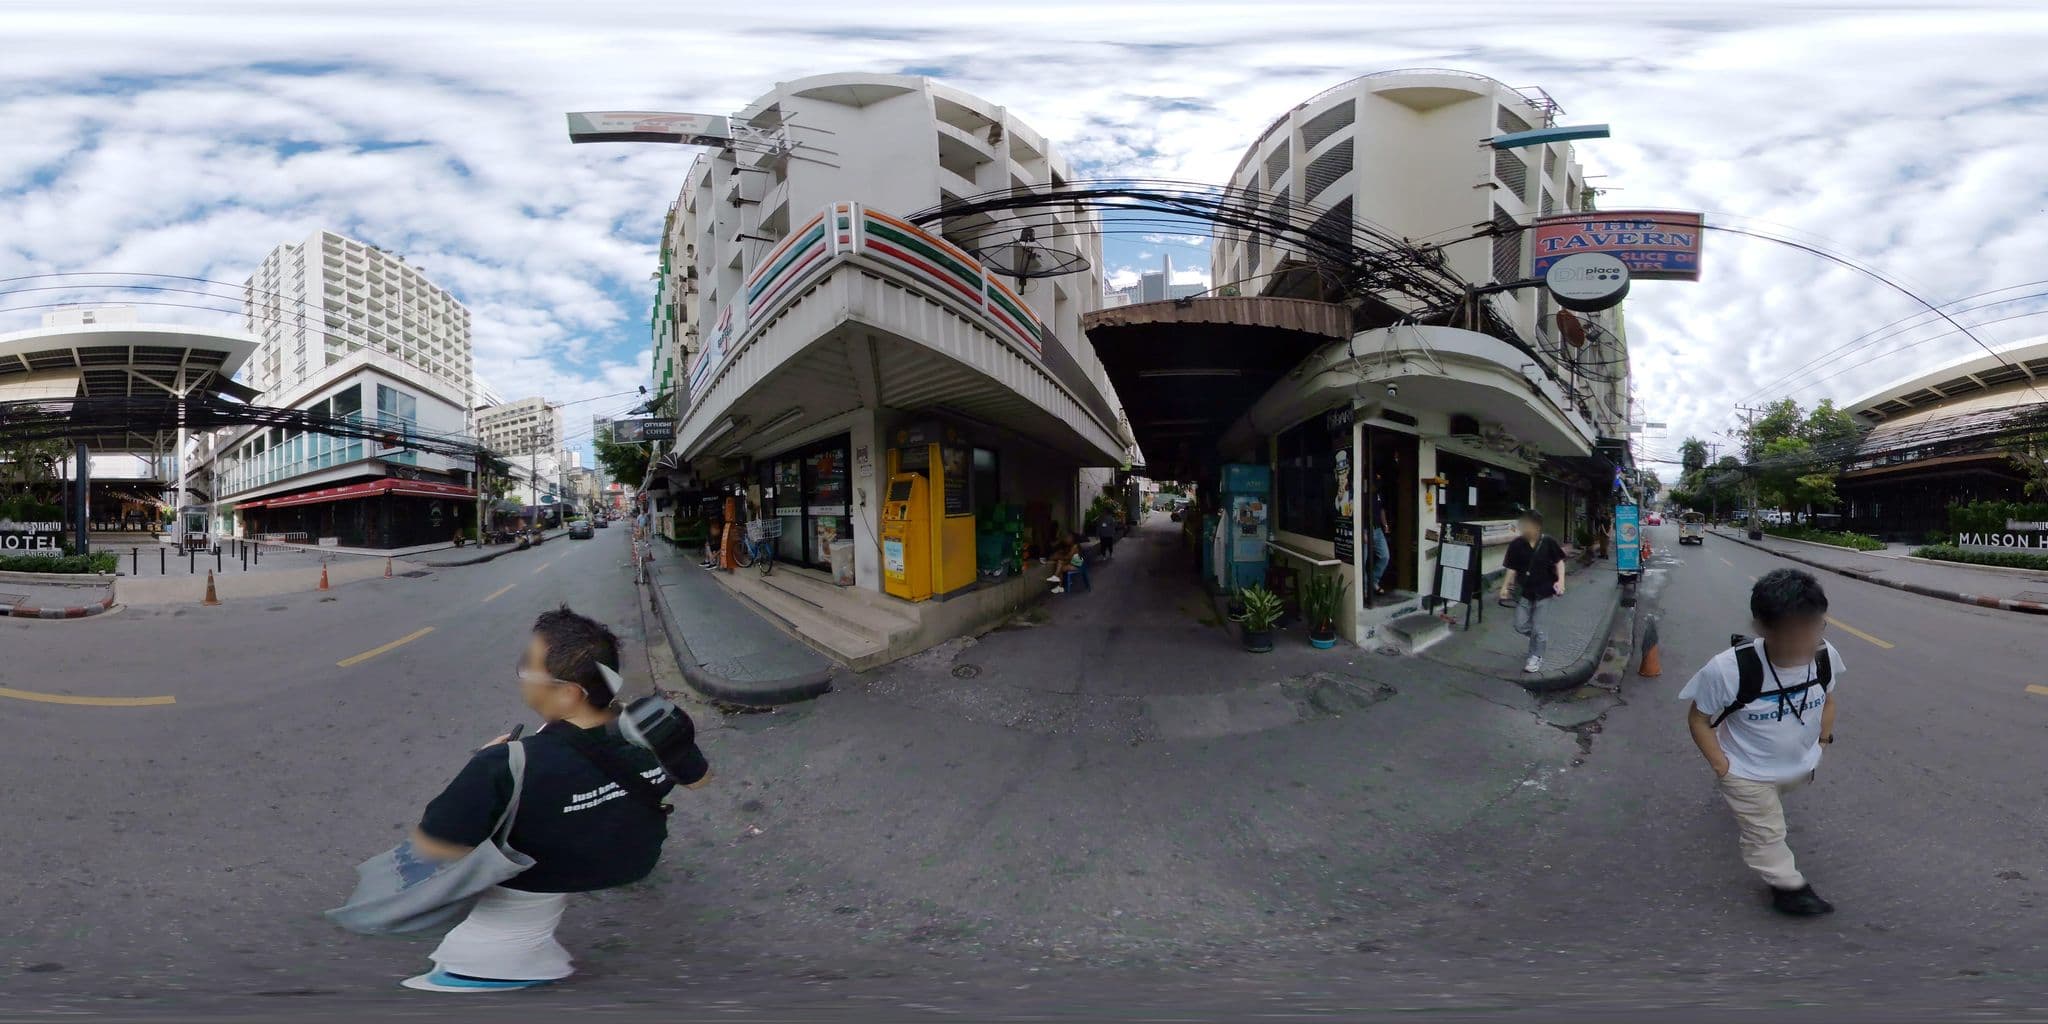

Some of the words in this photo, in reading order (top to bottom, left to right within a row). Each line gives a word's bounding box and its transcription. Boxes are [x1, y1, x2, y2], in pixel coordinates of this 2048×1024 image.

[1578, 218, 1657, 232] THE
[1541, 232, 1693, 251] TAVERN
[1620, 252, 1667, 262] SLICE
[1586, 266, 1621, 276] place
[1959, 532, 2029, 548] MAISON
